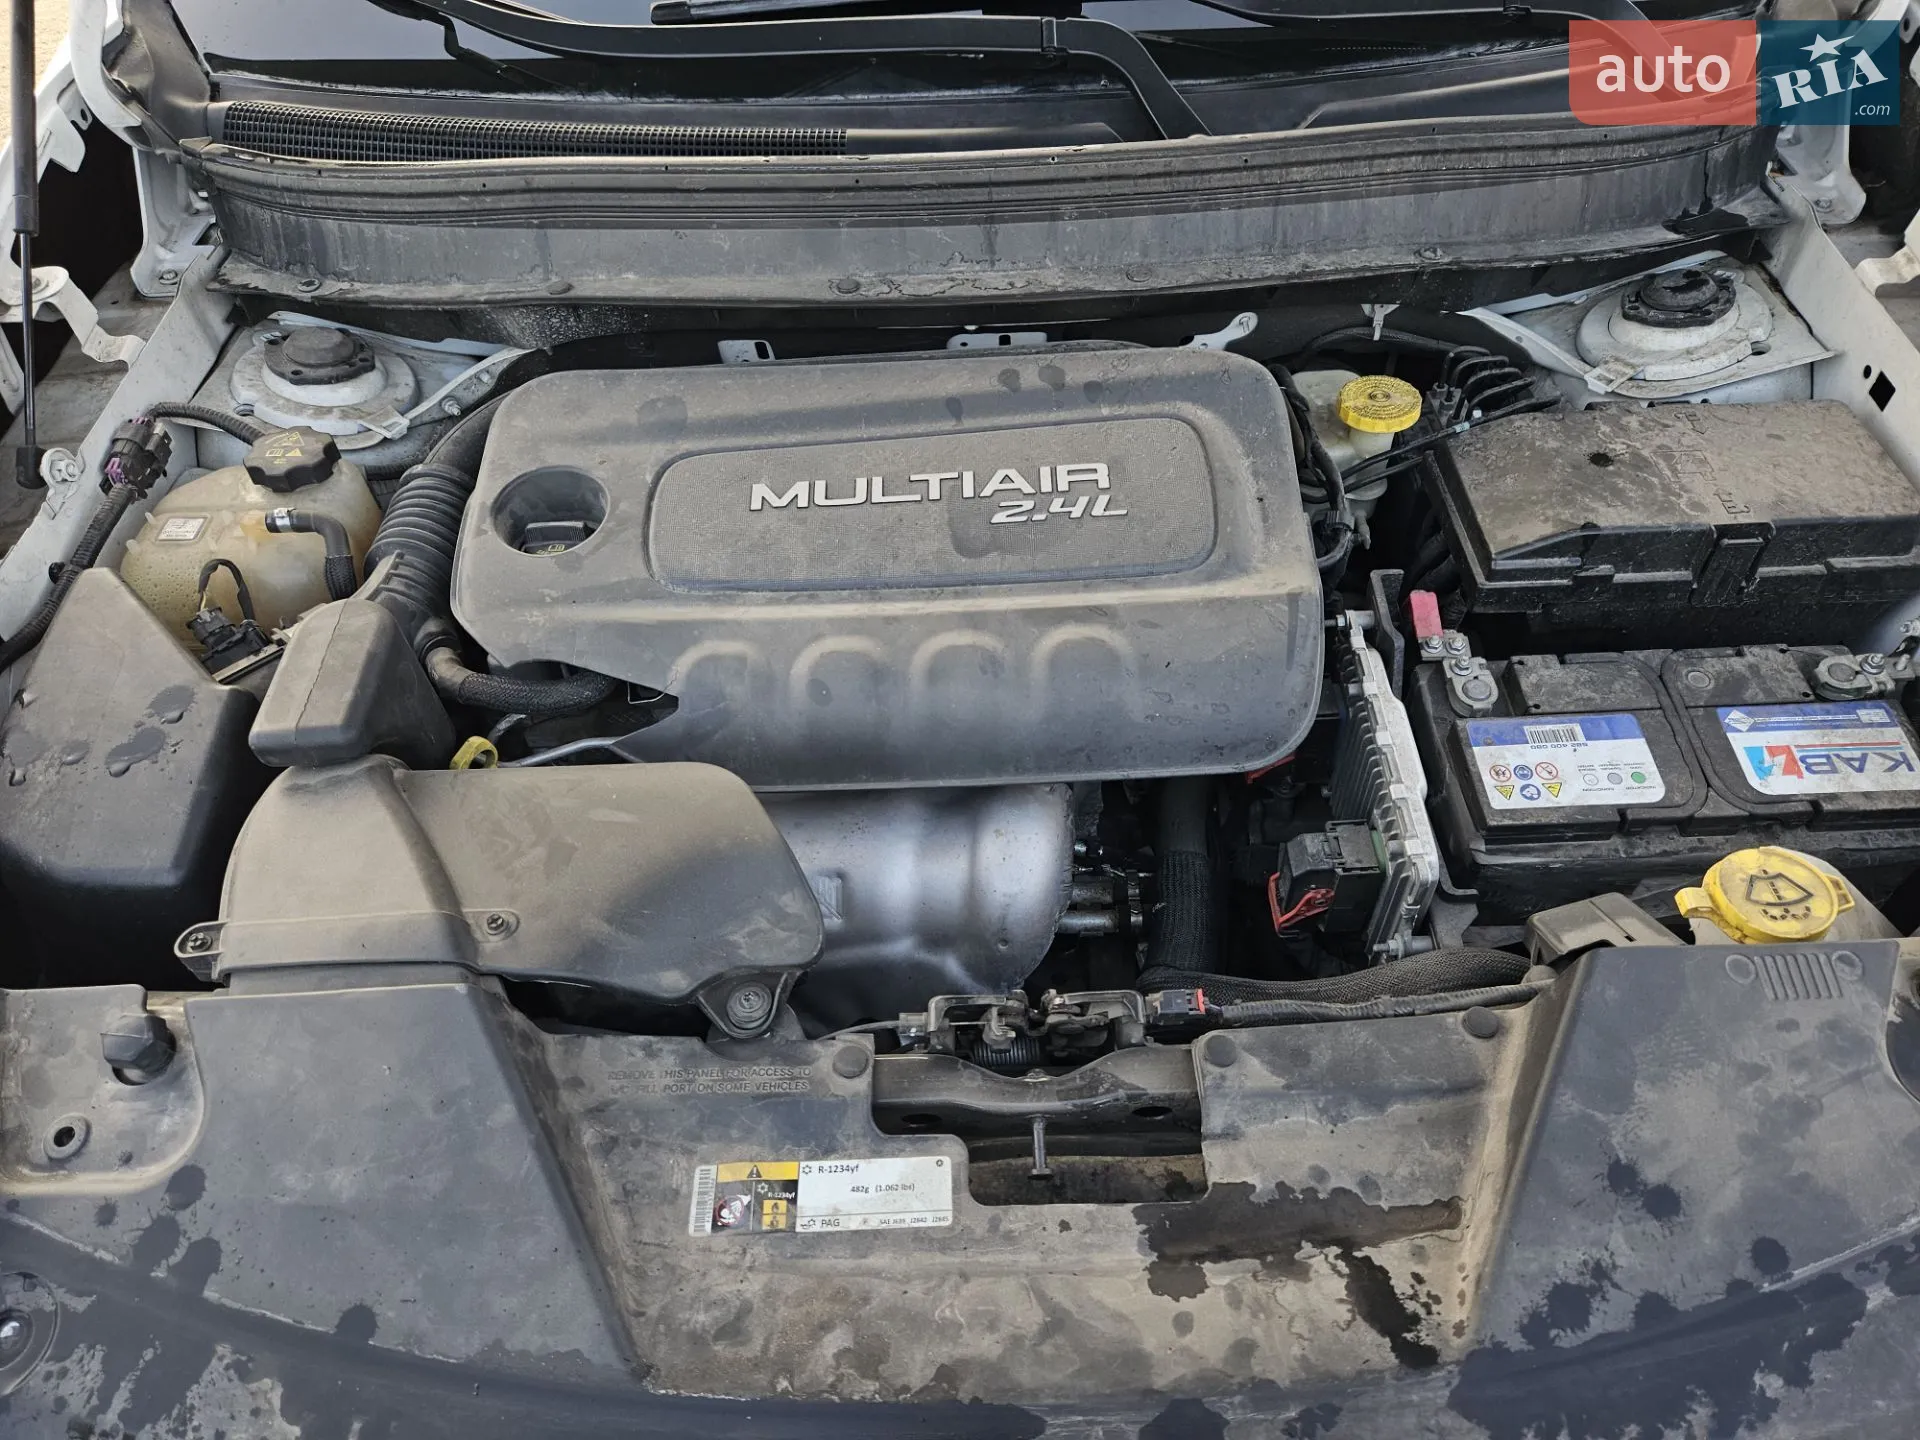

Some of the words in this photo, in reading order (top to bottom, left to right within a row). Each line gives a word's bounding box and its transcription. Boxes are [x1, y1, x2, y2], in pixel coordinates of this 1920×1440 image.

[749, 462, 1112, 512] MULTIAIR
[989, 494, 1128, 524] 2.4L
[660, 1068, 684, 1079] HIS
[686, 1068, 722, 1079] PANEL
[726, 1067, 752, 1079] FOR
[751, 1066, 794, 1078] ACCESS
[796, 1065, 811, 1077] TO
[663, 1082, 692, 1094] PORT
[697, 1082, 715, 1093] ON
[717, 1081, 750, 1093] SOME
[754, 1080, 809, 1092] VEHICLES
[817, 1163, 860, 1175] R-1234yf
[849, 1184, 870, 1195] 482g
[820, 1218, 841, 1227] PAG
